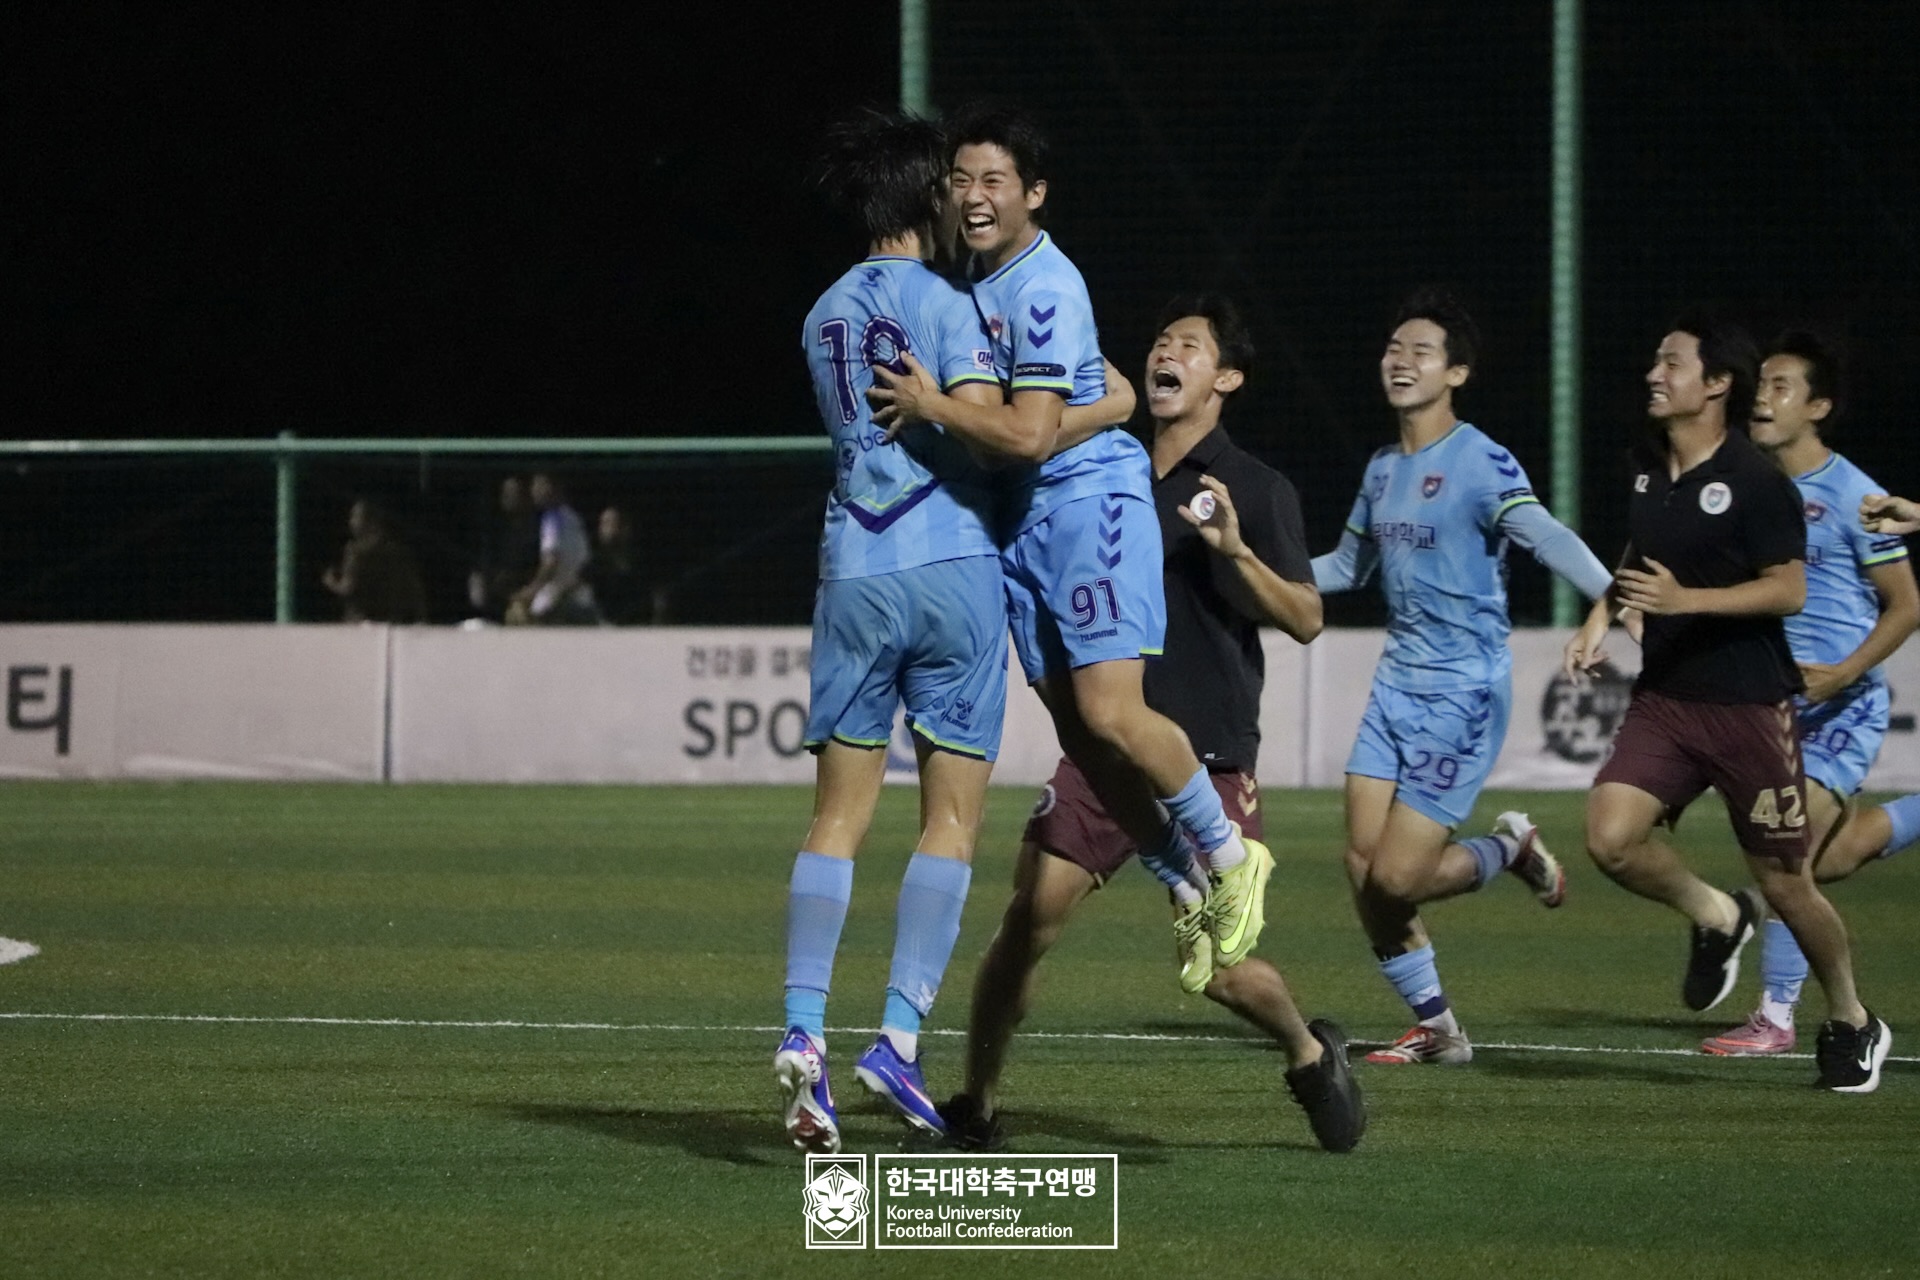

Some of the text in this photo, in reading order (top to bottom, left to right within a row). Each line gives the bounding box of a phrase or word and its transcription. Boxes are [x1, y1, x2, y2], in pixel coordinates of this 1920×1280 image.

[1070, 577, 1121, 631] 91
[1080, 626, 1118, 643] hummel
[1407, 750, 1459, 791] 29
[1749, 784, 1806, 829] 42
